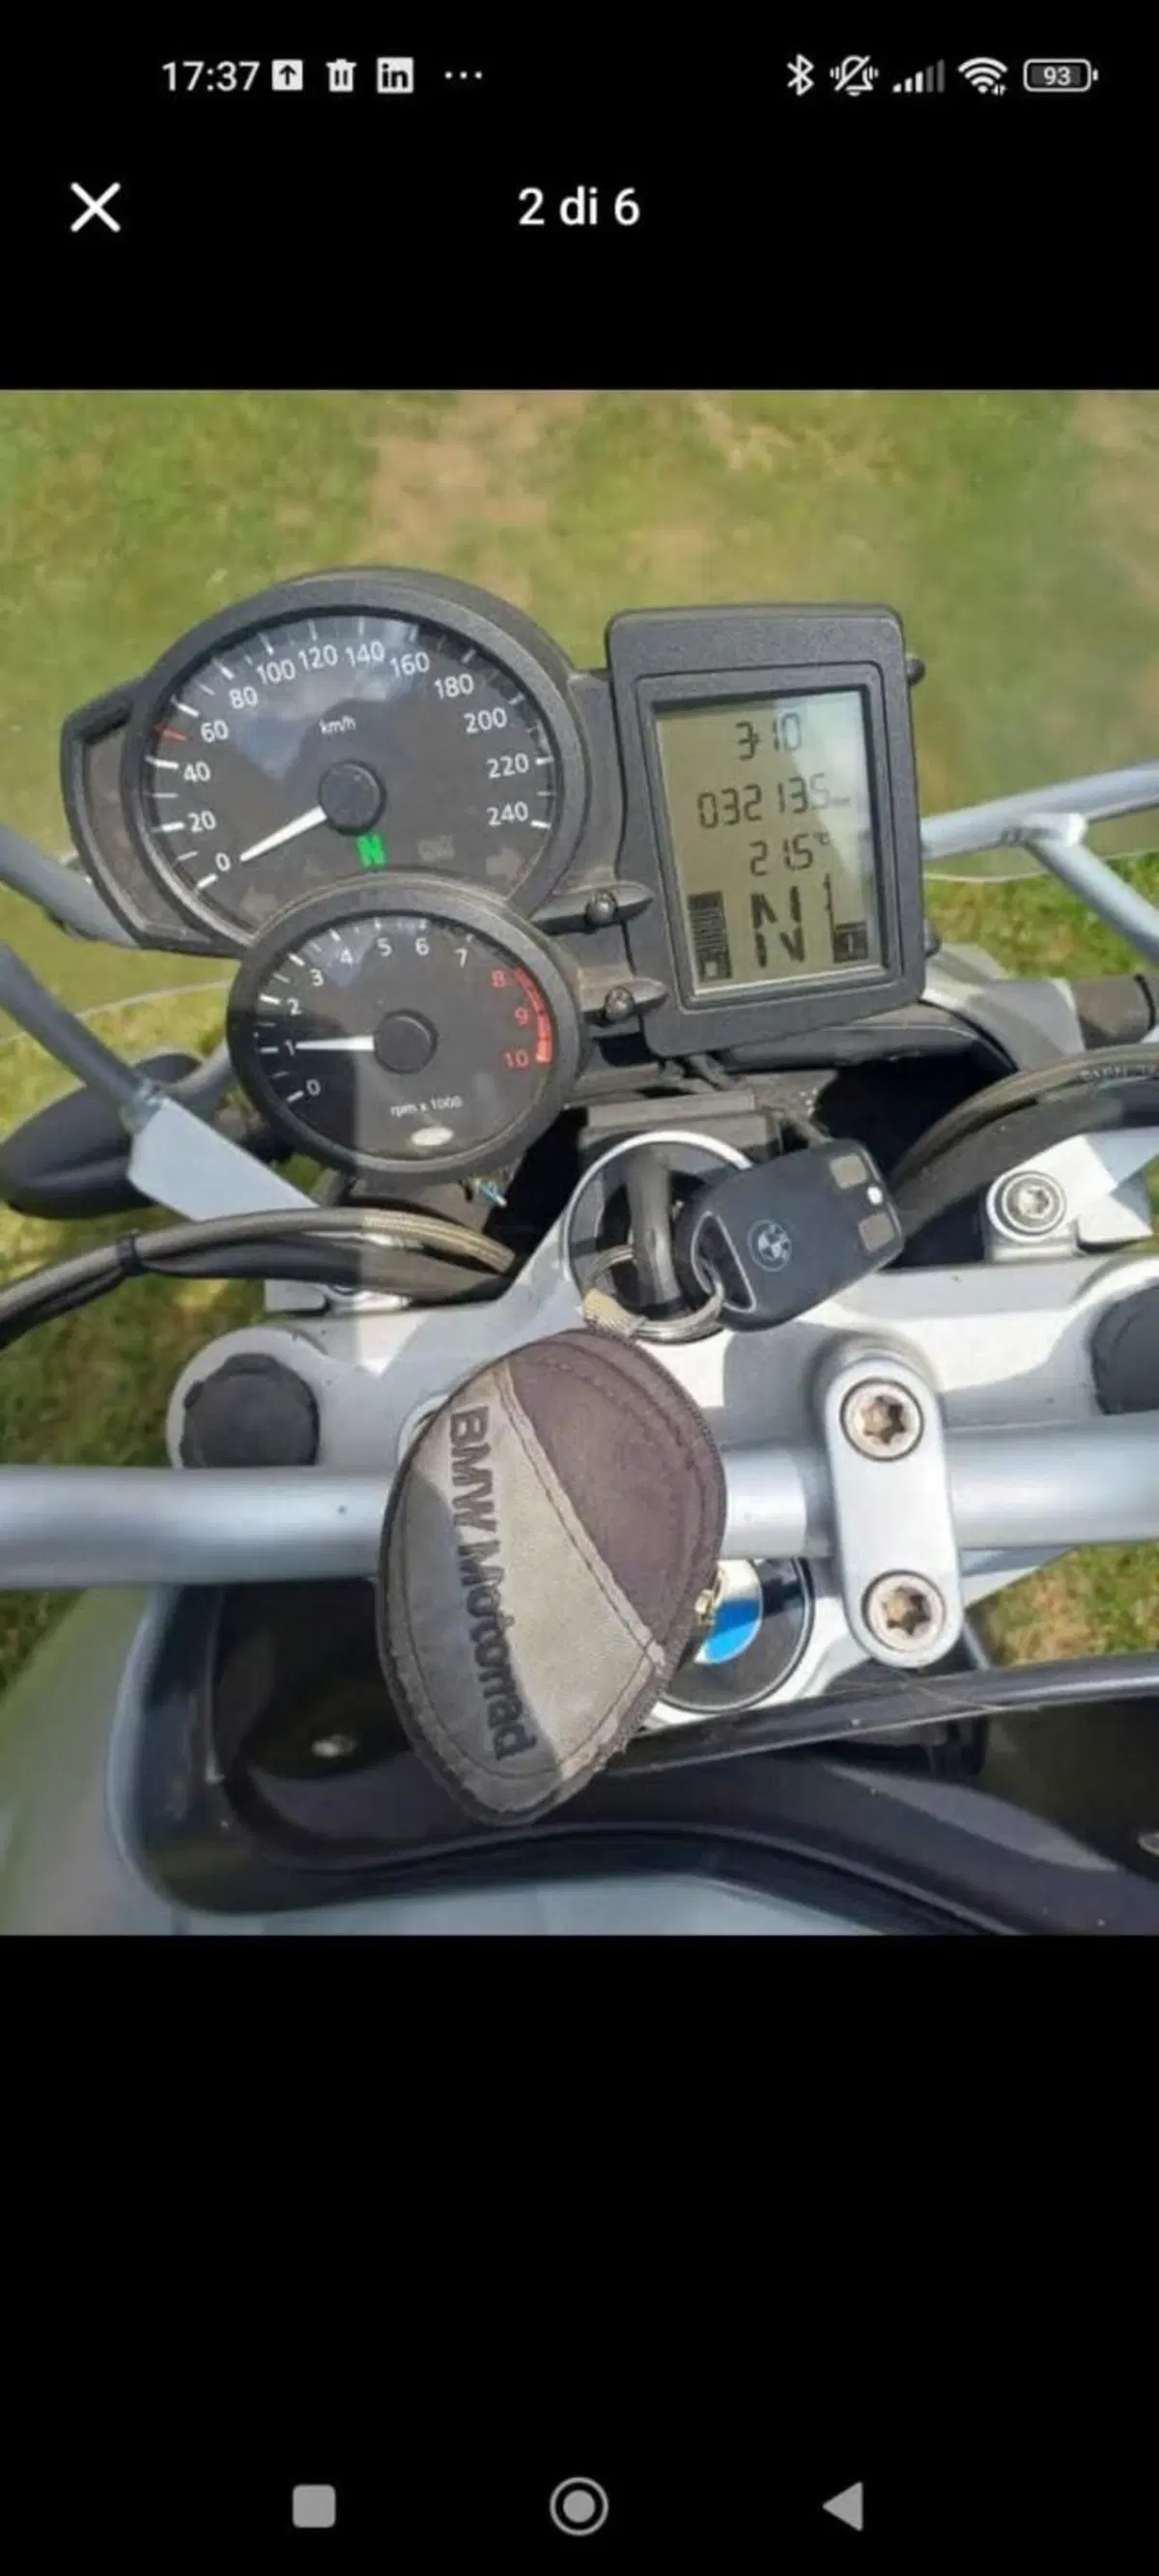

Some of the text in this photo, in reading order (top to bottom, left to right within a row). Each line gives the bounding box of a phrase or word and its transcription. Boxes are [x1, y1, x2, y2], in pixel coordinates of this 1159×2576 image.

[297, 644, 339, 671] 120
[344, 641, 386, 669] 140
[390, 651, 431, 676] 160
[256, 659, 297, 687] 100
[434, 673, 475, 700] 180
[230, 686, 259, 711] 80
[200, 719, 229, 744] 60
[319, 715, 356, 735] km/h
[464, 708, 508, 734] 200
[183, 764, 212, 784] 40
[486, 754, 530, 779] 220
[188, 811, 216, 832] 20
[486, 801, 530, 828] 240
[355, 832, 386, 867] N
[214, 852, 232, 873] 0
[749, 885, 807, 969] N
[340, 949, 353, 965] 4
[377, 937, 392, 958] 5
[414, 936, 430, 957] 6
[456, 948, 468, 967] 7
[309, 968, 325, 987] 3
[492, 969, 506, 988] 8
[286, 997, 301, 1016] 2
[514, 1006, 530, 1027] 9
[283, 1037, 296, 1056] 1
[502, 1049, 530, 1070] 10
[305, 1077, 322, 1097] 0
[449, 1405, 538, 1761] BMW Motorrad
